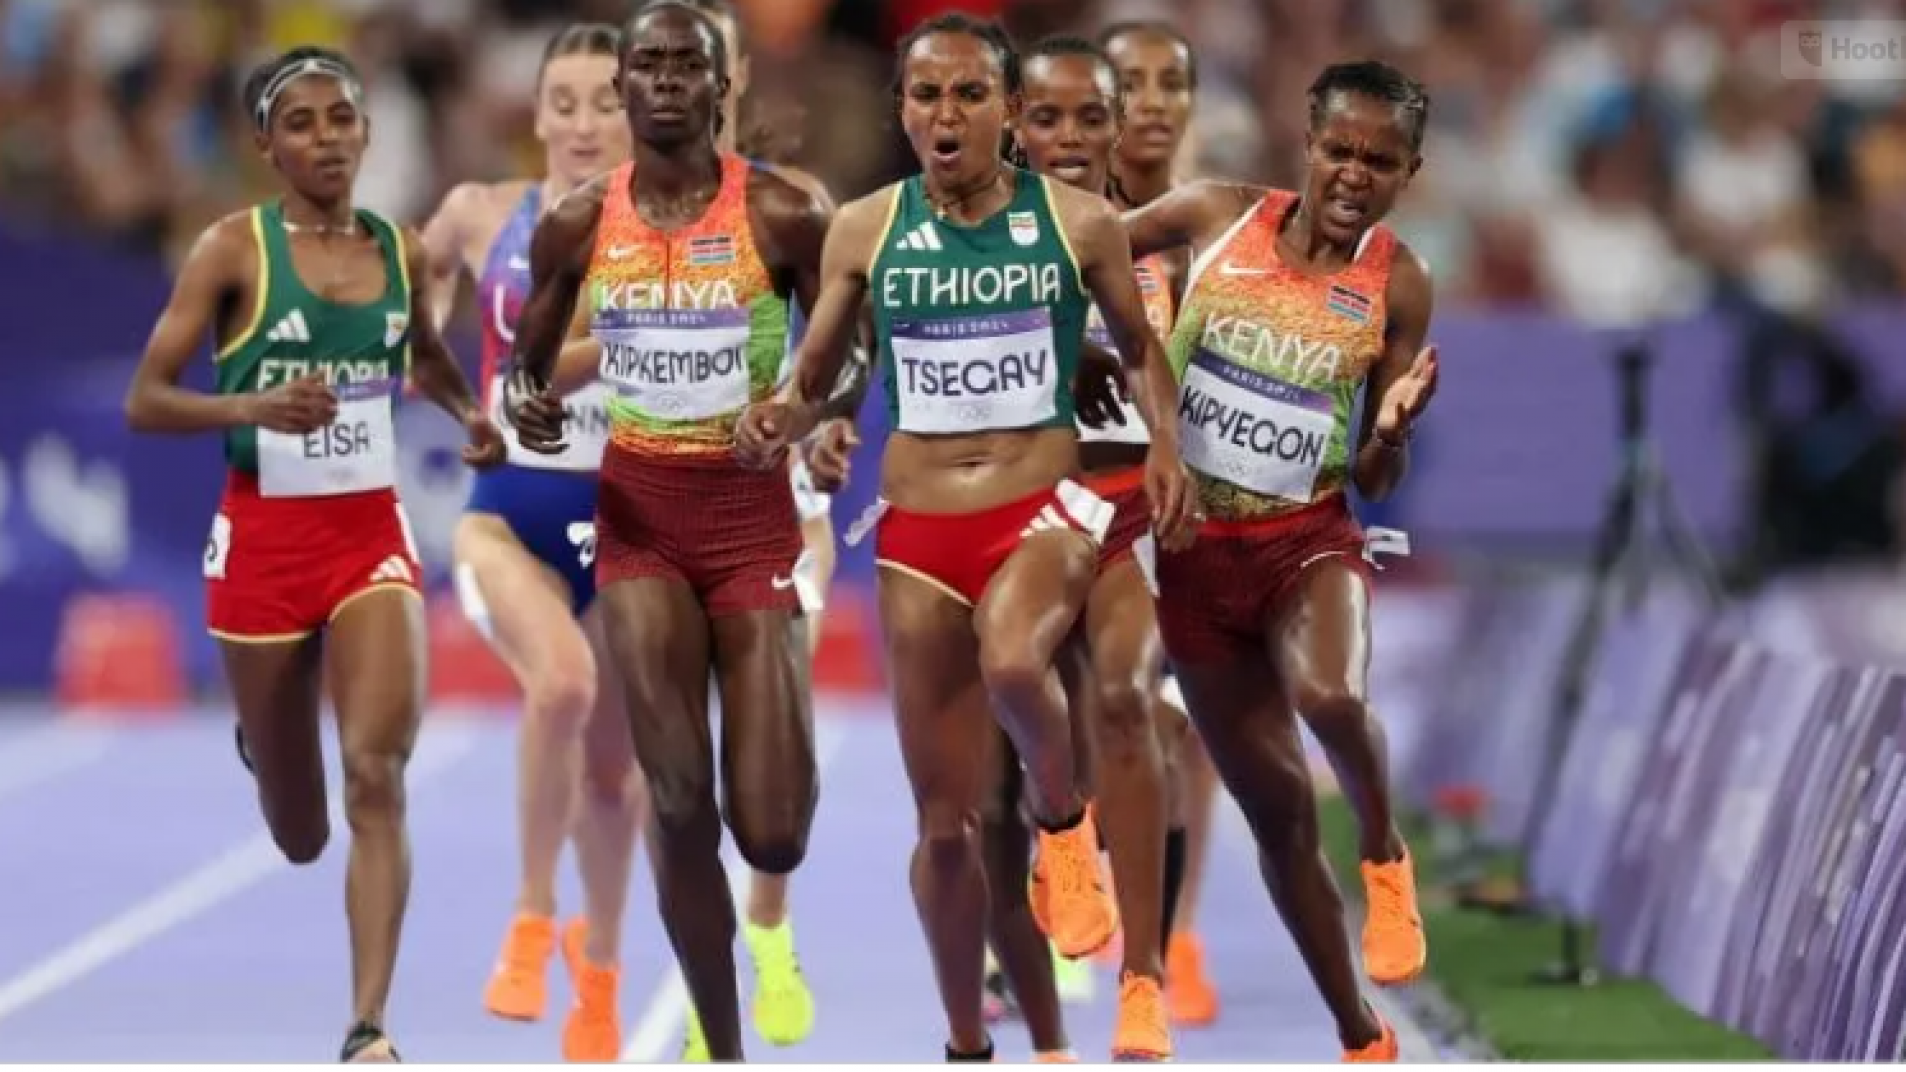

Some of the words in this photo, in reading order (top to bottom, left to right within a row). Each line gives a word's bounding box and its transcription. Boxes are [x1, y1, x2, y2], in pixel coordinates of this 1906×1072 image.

[602, 279, 738, 310] KENYA
[883, 262, 1061, 308] ETHIOPIA
[604, 342, 742, 384] KIPKEMBOI
[1203, 313, 1342, 382] KENYA
[901, 349, 1047, 397] TSEGAY
[303, 420, 371, 458] EISA
[1179, 384, 1324, 466] KIPYEGON
